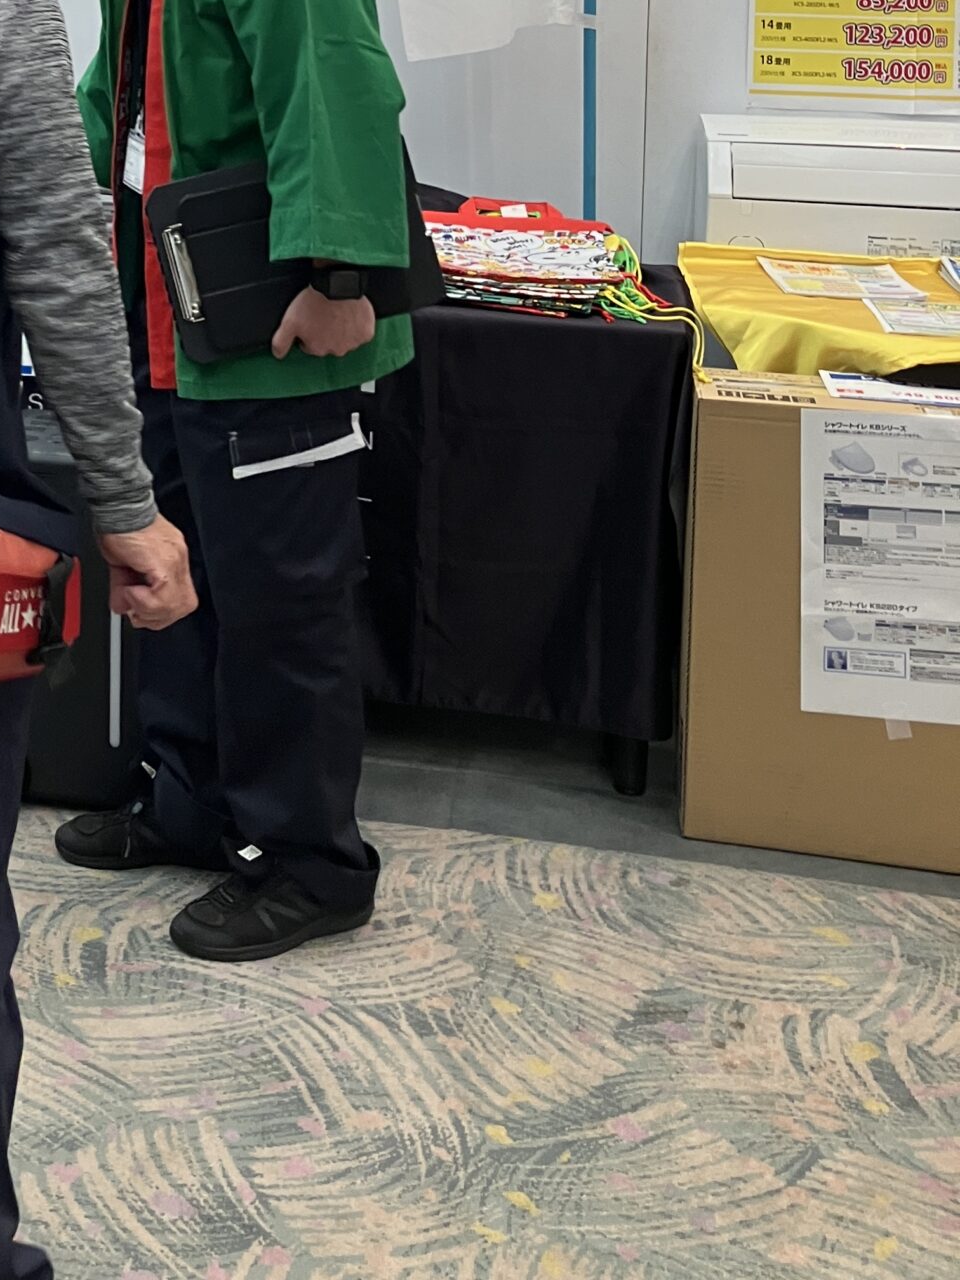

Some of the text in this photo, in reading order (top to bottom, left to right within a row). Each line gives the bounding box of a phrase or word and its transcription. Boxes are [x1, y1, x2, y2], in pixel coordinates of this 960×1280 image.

[843, 22, 934, 49] 123,200
[841, 58, 934, 85] 154,000
[824, 421, 867, 430] シャワートイレ
[0, 602, 20, 634] ALL
[824, 599, 868, 610] シャワートイレ
